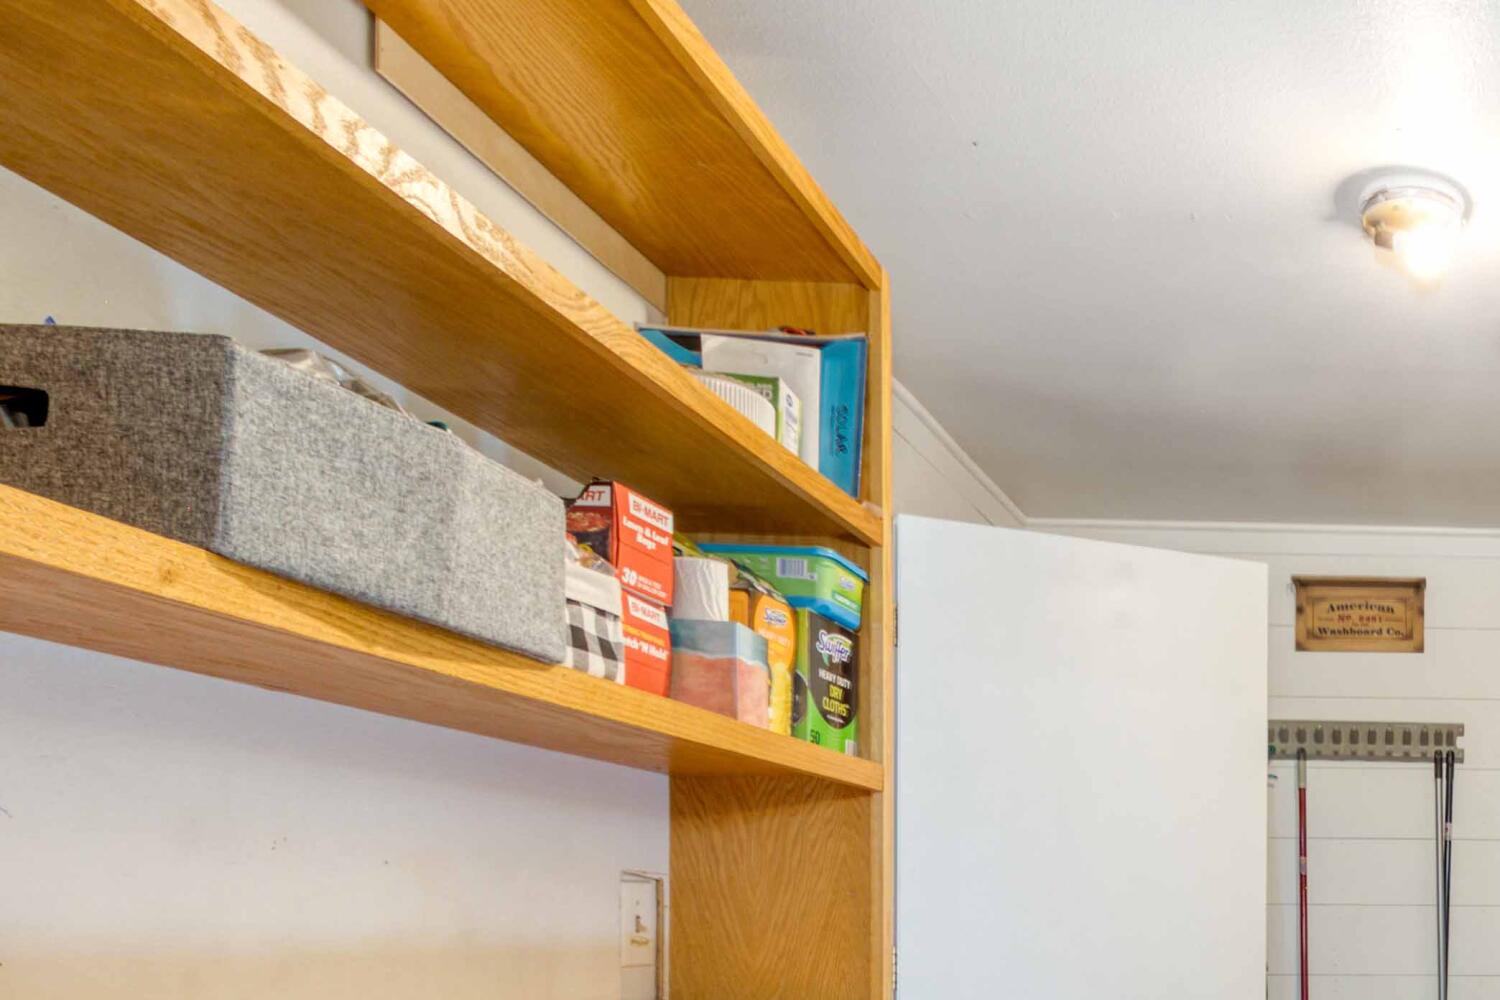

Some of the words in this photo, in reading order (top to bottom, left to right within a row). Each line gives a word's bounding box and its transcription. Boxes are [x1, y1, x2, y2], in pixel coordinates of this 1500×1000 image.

[1327, 600, 1395, 615] American
[1317, 626, 1383, 636] Washboard
[816, 629, 852, 663] Swiffer
[818, 667, 836, 684] HEAVY
[836, 674, 852, 690] DUTY
[829, 683, 845, 701] DRY
